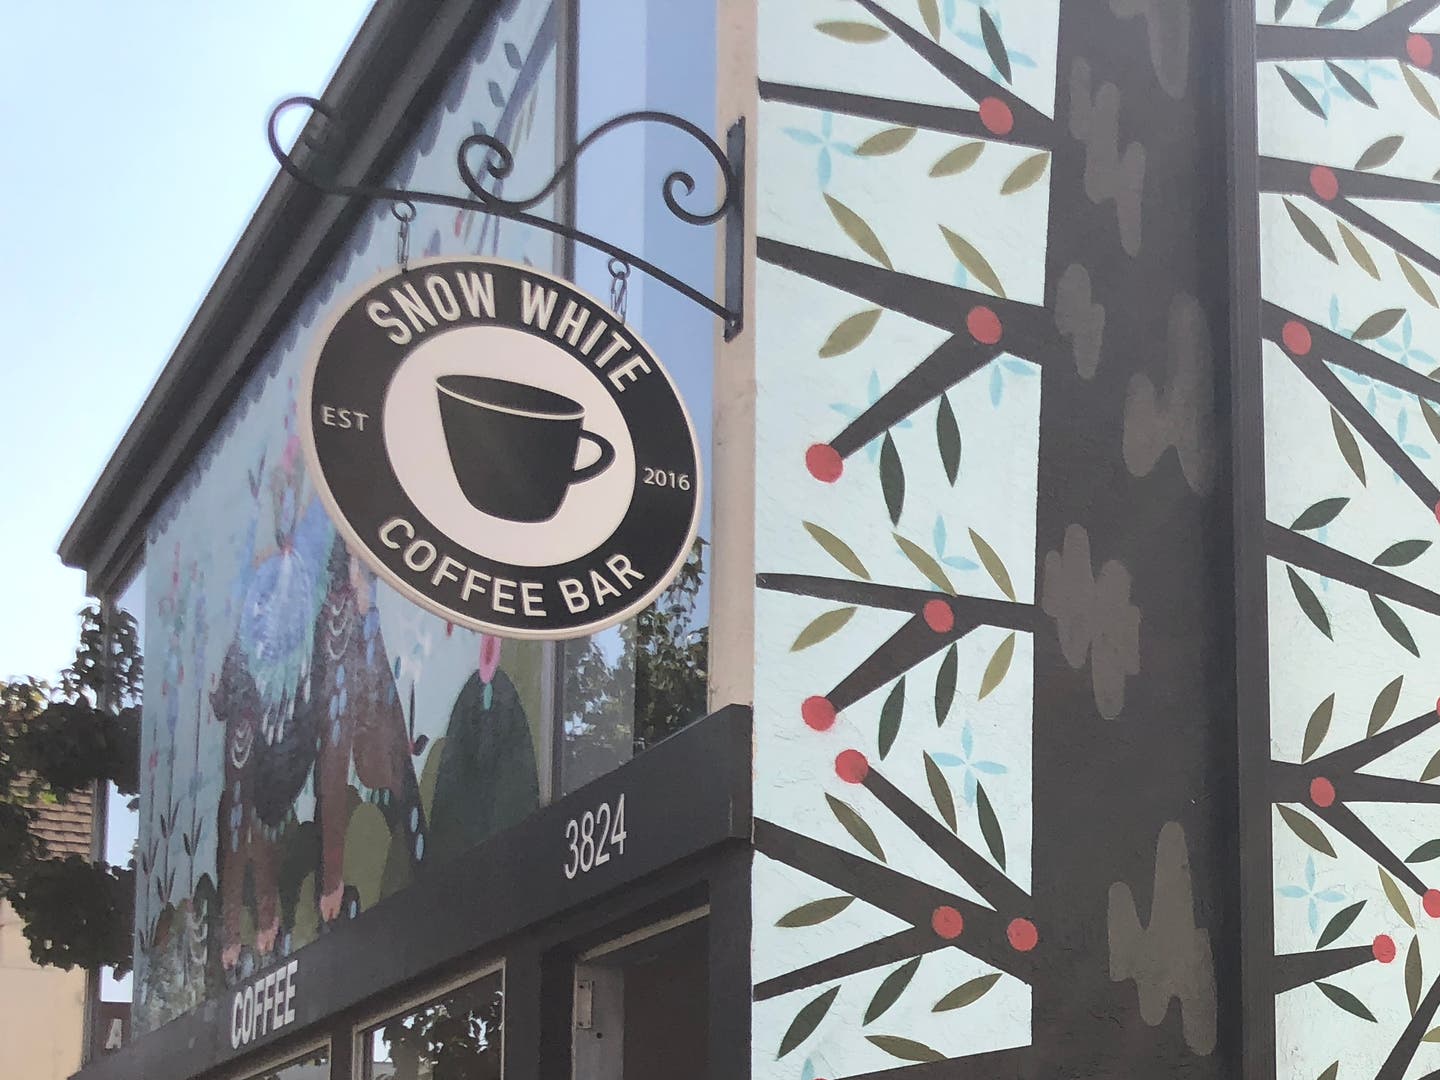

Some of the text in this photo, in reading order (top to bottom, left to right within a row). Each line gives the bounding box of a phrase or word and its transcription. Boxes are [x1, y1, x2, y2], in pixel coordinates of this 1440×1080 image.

[367, 272, 652, 393] SNOW WHITE
[321, 405, 369, 432] EST
[643, 467, 691, 491] 2016
[378, 518, 645, 617] COFFEE BAR
[564, 793, 627, 879] 3824
[231, 960, 298, 1050] COFFEE
